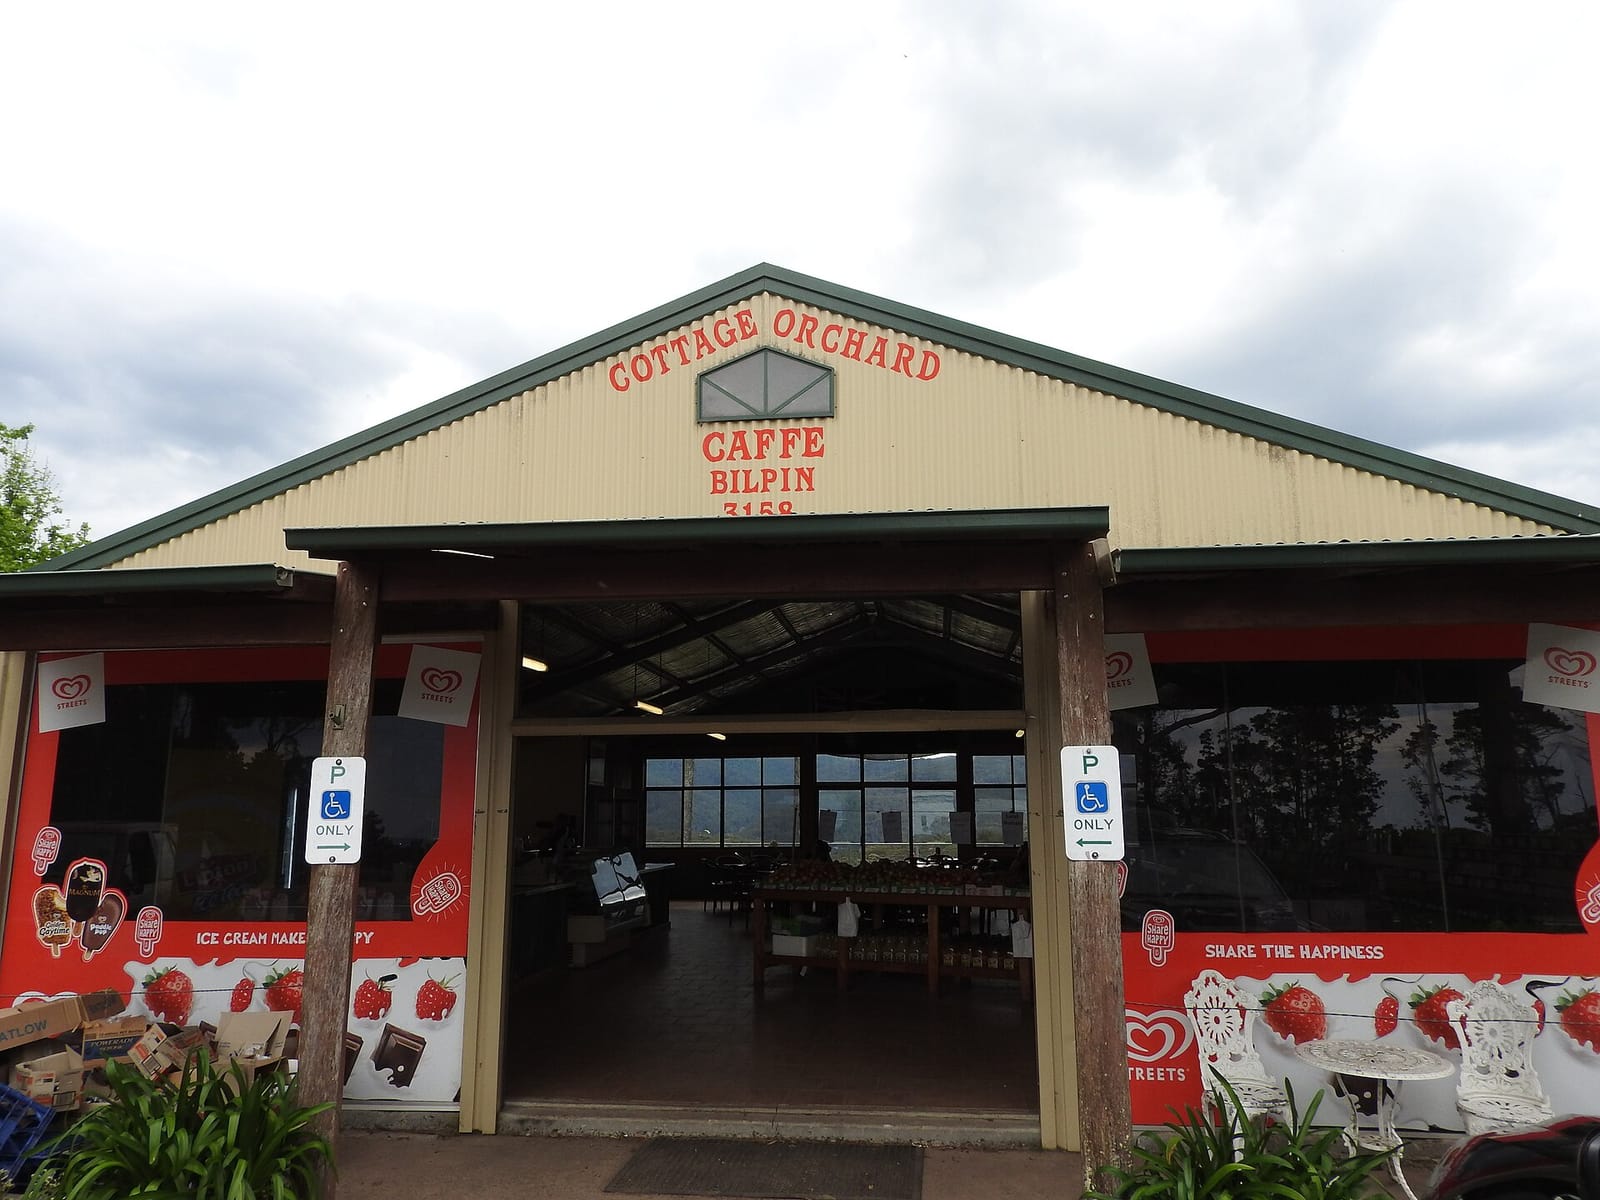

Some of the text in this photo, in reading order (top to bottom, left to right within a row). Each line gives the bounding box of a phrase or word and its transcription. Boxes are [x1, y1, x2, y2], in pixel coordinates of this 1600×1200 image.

[608, 308, 942, 392] COTTAGE ORCHARD
[702, 427, 825, 462] CAFFE
[710, 467, 815, 494] BILPIN
[1548, 675, 1589, 689] STREETS
[57, 699, 87, 710] STREETS
[421, 693, 454, 704] STREETS
[1083, 755, 1098, 774] P
[330, 766, 346, 784] P
[316, 825, 354, 836] ONLY
[1074, 819, 1113, 830] ONLY
[69, 888, 101, 897] MAGNUM
[196, 932, 306, 945] ICE CREAM MAKE
[1205, 944, 1384, 960] SHARE THE HAPPINESS
[0, 1020, 47, 1040] ATLOW
[1128, 1067, 1186, 1081] TREETS
